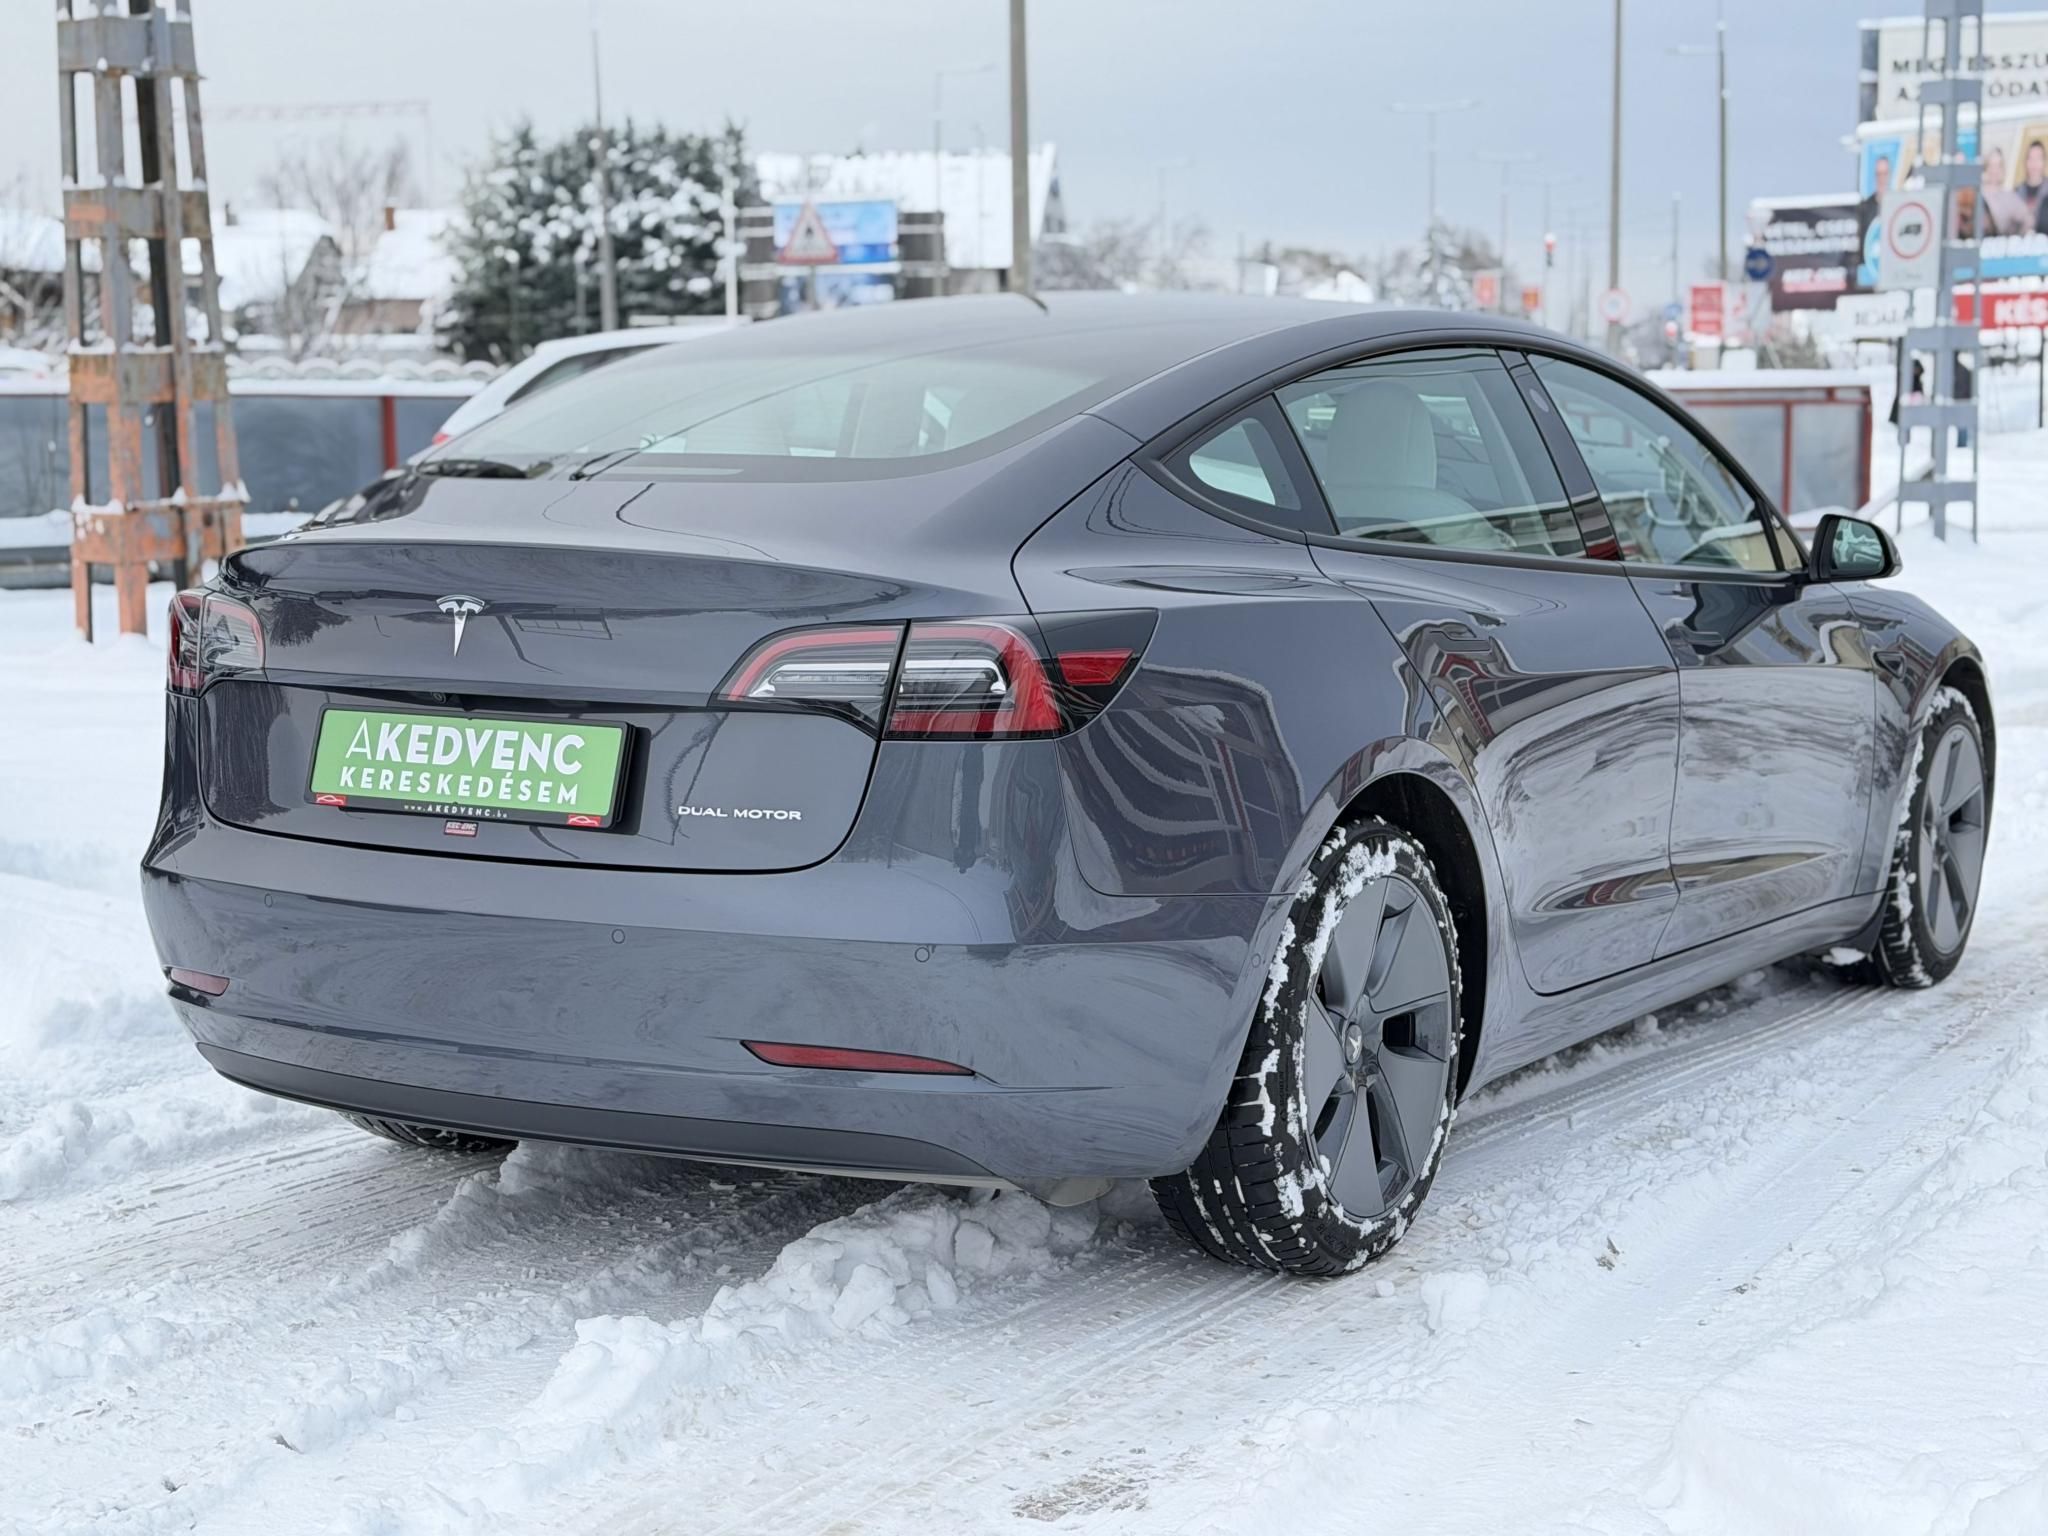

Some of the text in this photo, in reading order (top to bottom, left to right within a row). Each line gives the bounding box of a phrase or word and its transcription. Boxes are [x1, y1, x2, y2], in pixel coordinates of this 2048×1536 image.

[345, 718, 585, 775] AKEDVENC
[339, 766, 578, 805] KERESKEDÉSEM
[678, 806, 802, 820] DUAL MOTOR
